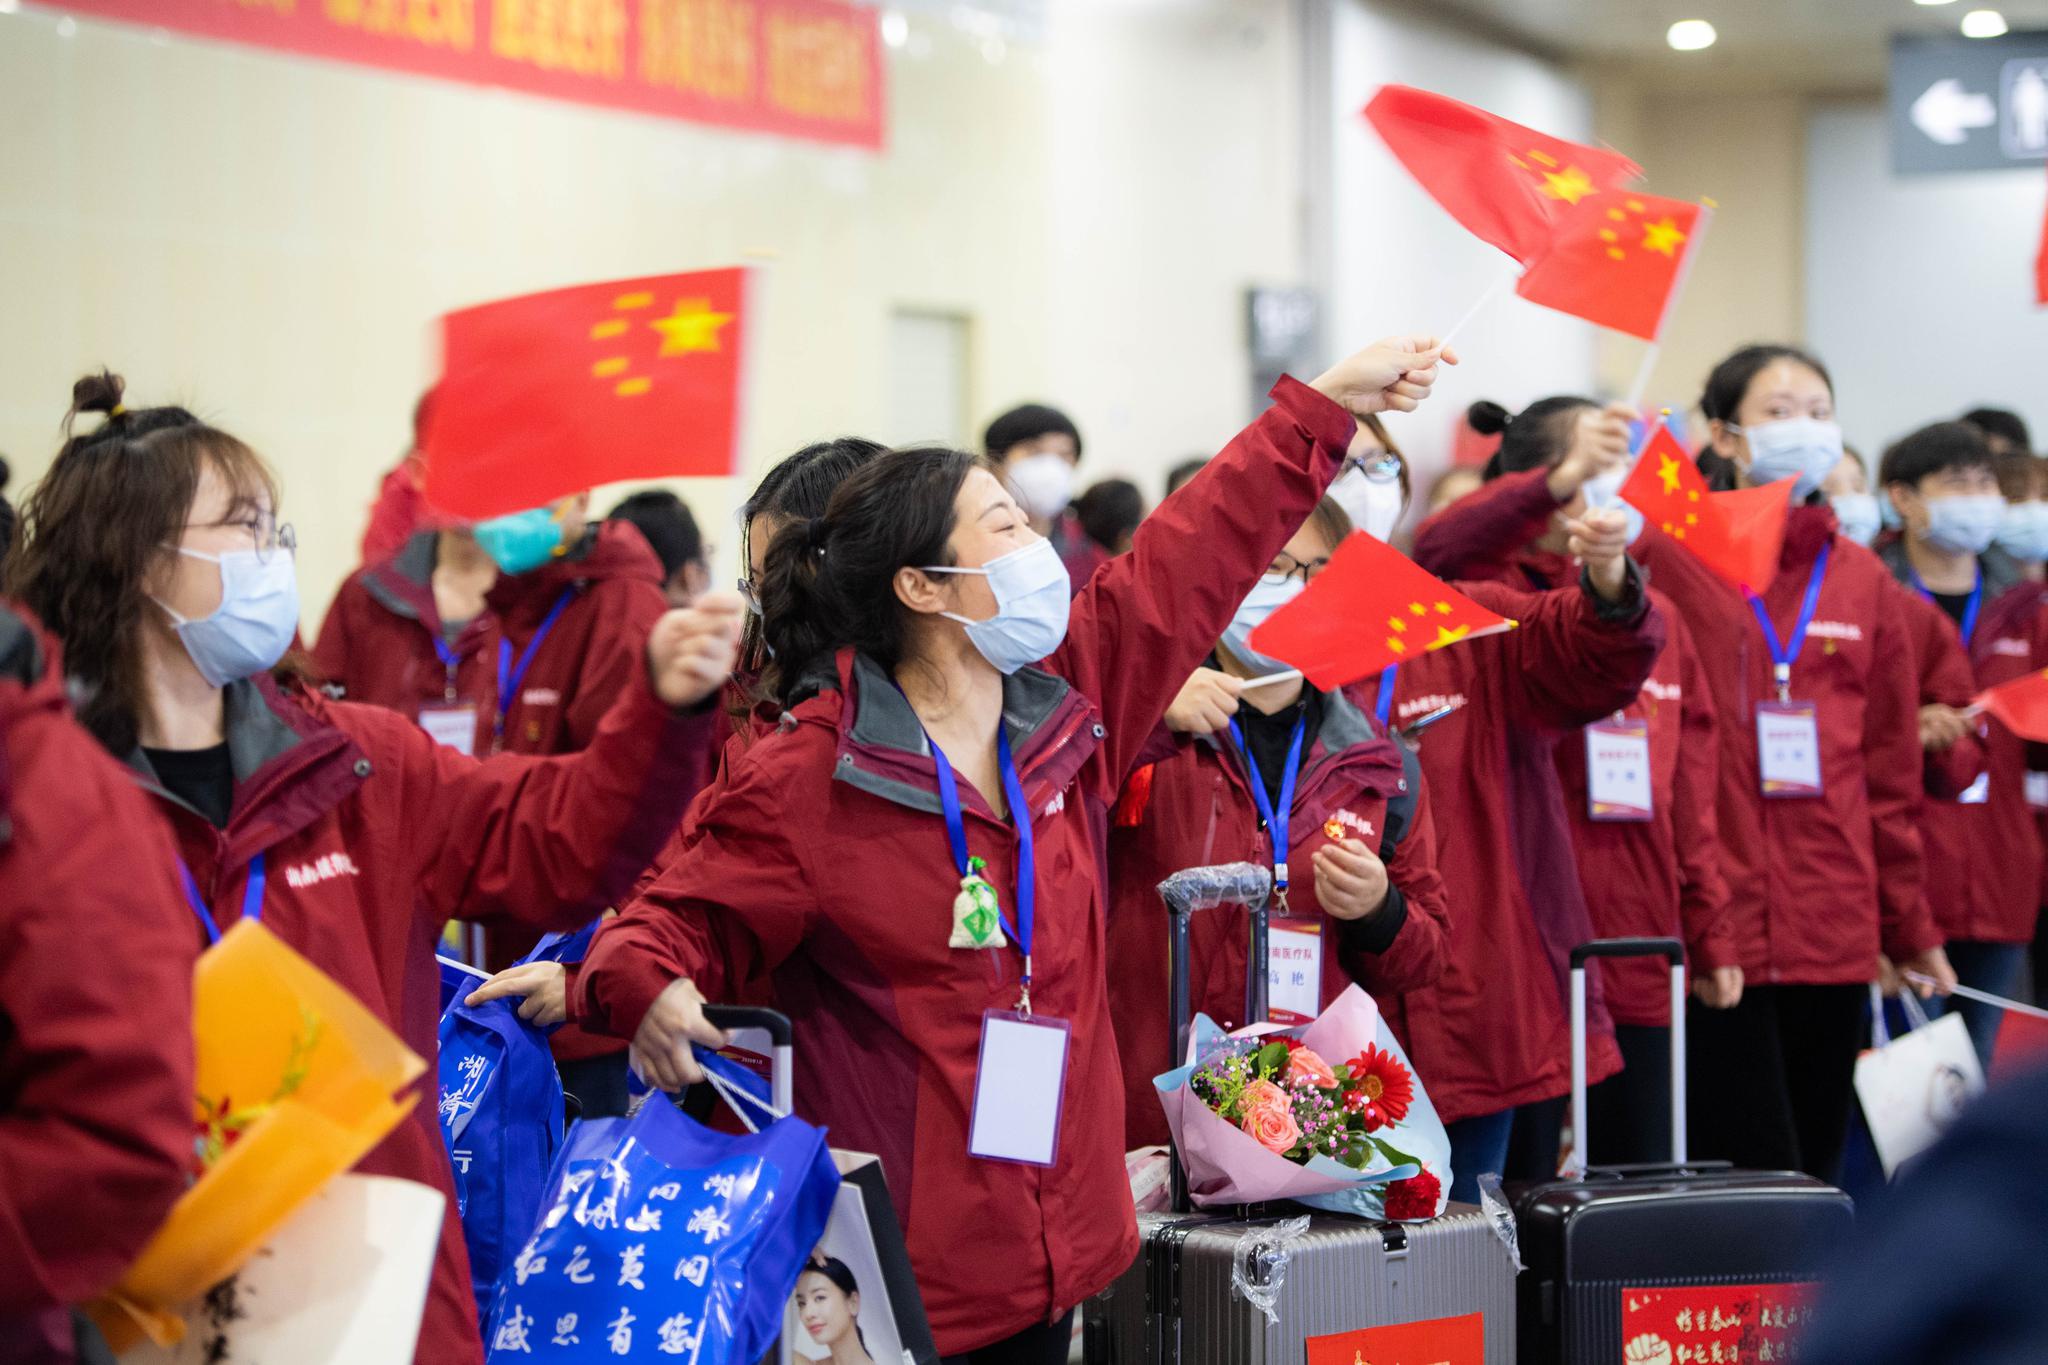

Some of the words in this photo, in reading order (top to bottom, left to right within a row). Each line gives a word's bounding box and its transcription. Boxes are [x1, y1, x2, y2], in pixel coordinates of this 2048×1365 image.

[1269, 946, 1314, 960] 南医疗队
[494, 1304, 699, 1355] 感恩有您
